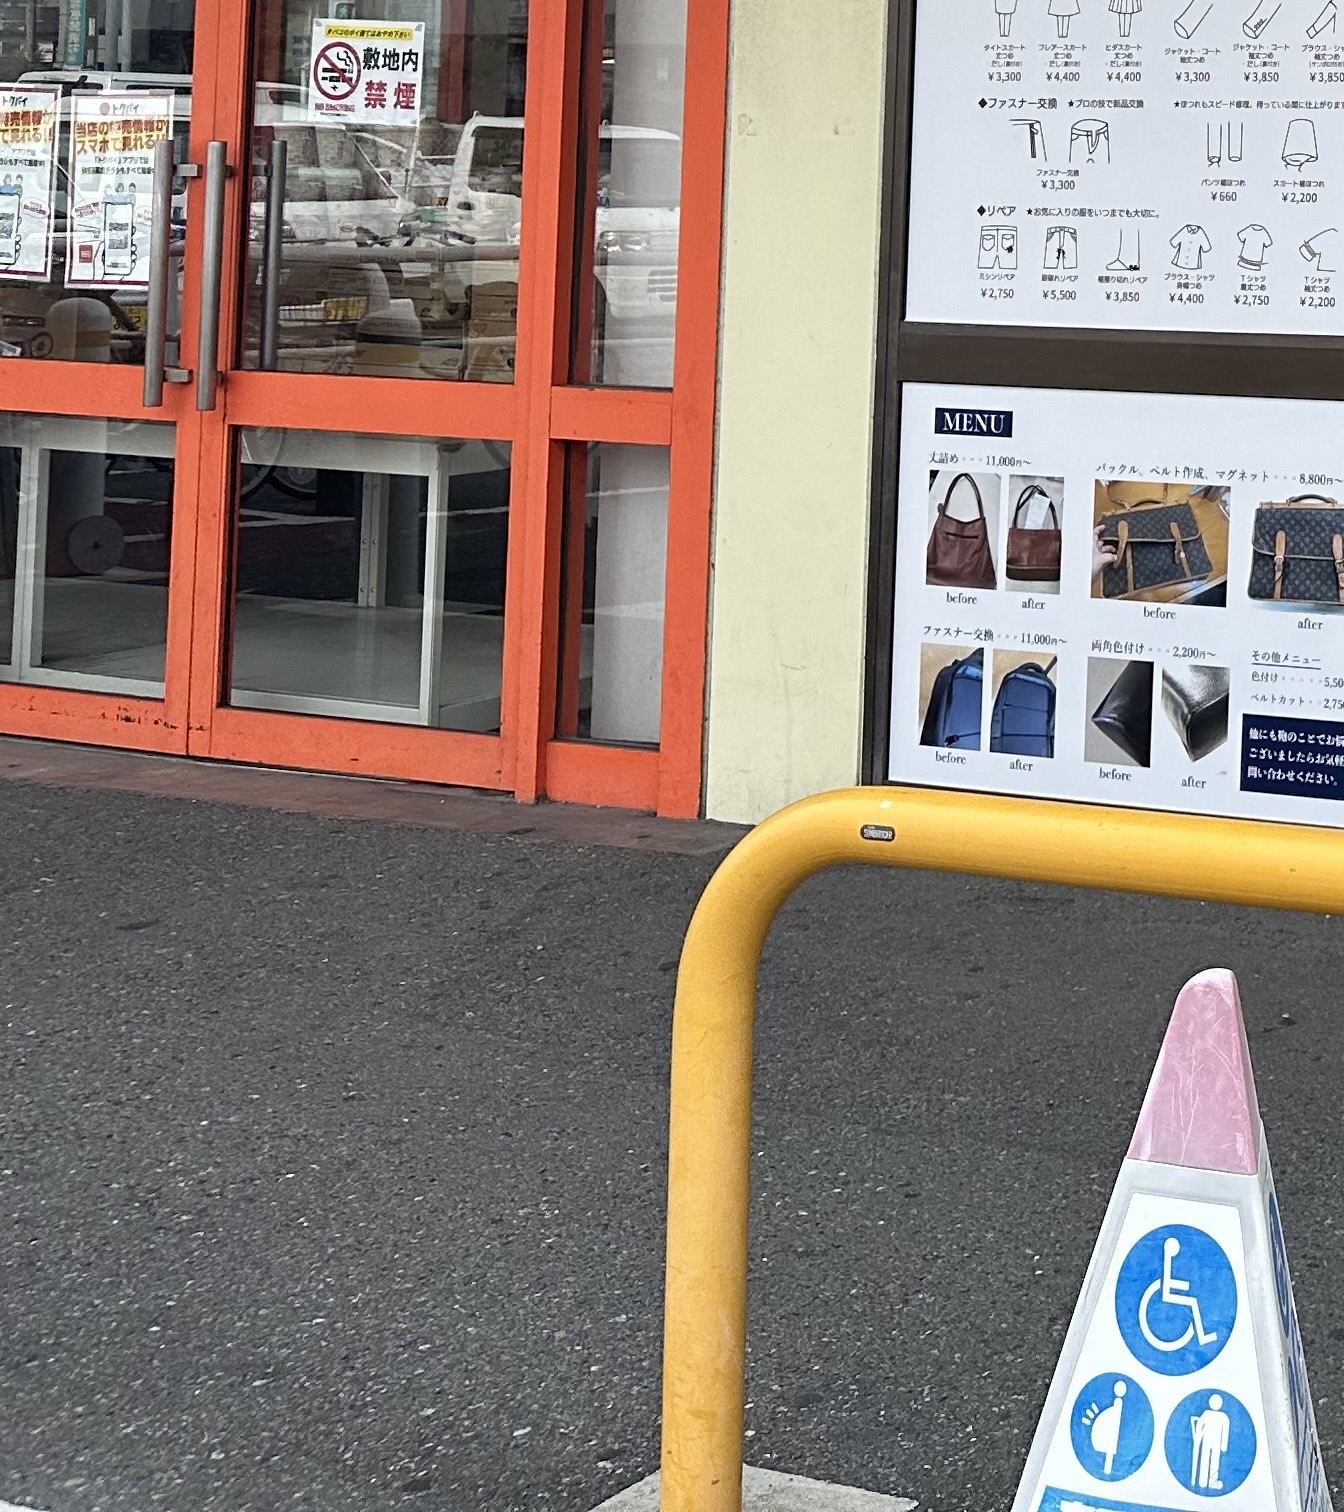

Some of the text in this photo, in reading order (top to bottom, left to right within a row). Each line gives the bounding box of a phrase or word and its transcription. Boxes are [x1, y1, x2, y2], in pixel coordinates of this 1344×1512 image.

[362, 46, 419, 72] 敷地内
[3, 96, 28, 107] トクバイ
[987, 97, 1058, 109] ファスナー交換
[113, 103, 140, 115] トクバイ
[987, 205, 1017, 217] リペア
[942, 411, 1006, 433] MENU
[946, 592, 978, 605] before
[1021, 597, 1046, 610] after
[1143, 606, 1176, 620] before
[1297, 618, 1324, 630] after
[1251, 650, 1321, 664] その他メニュー
[935, 751, 967, 765] before
[1009, 759, 1034, 772] after
[1098, 766, 1132, 782] before
[1181, 776, 1207, 789] after
